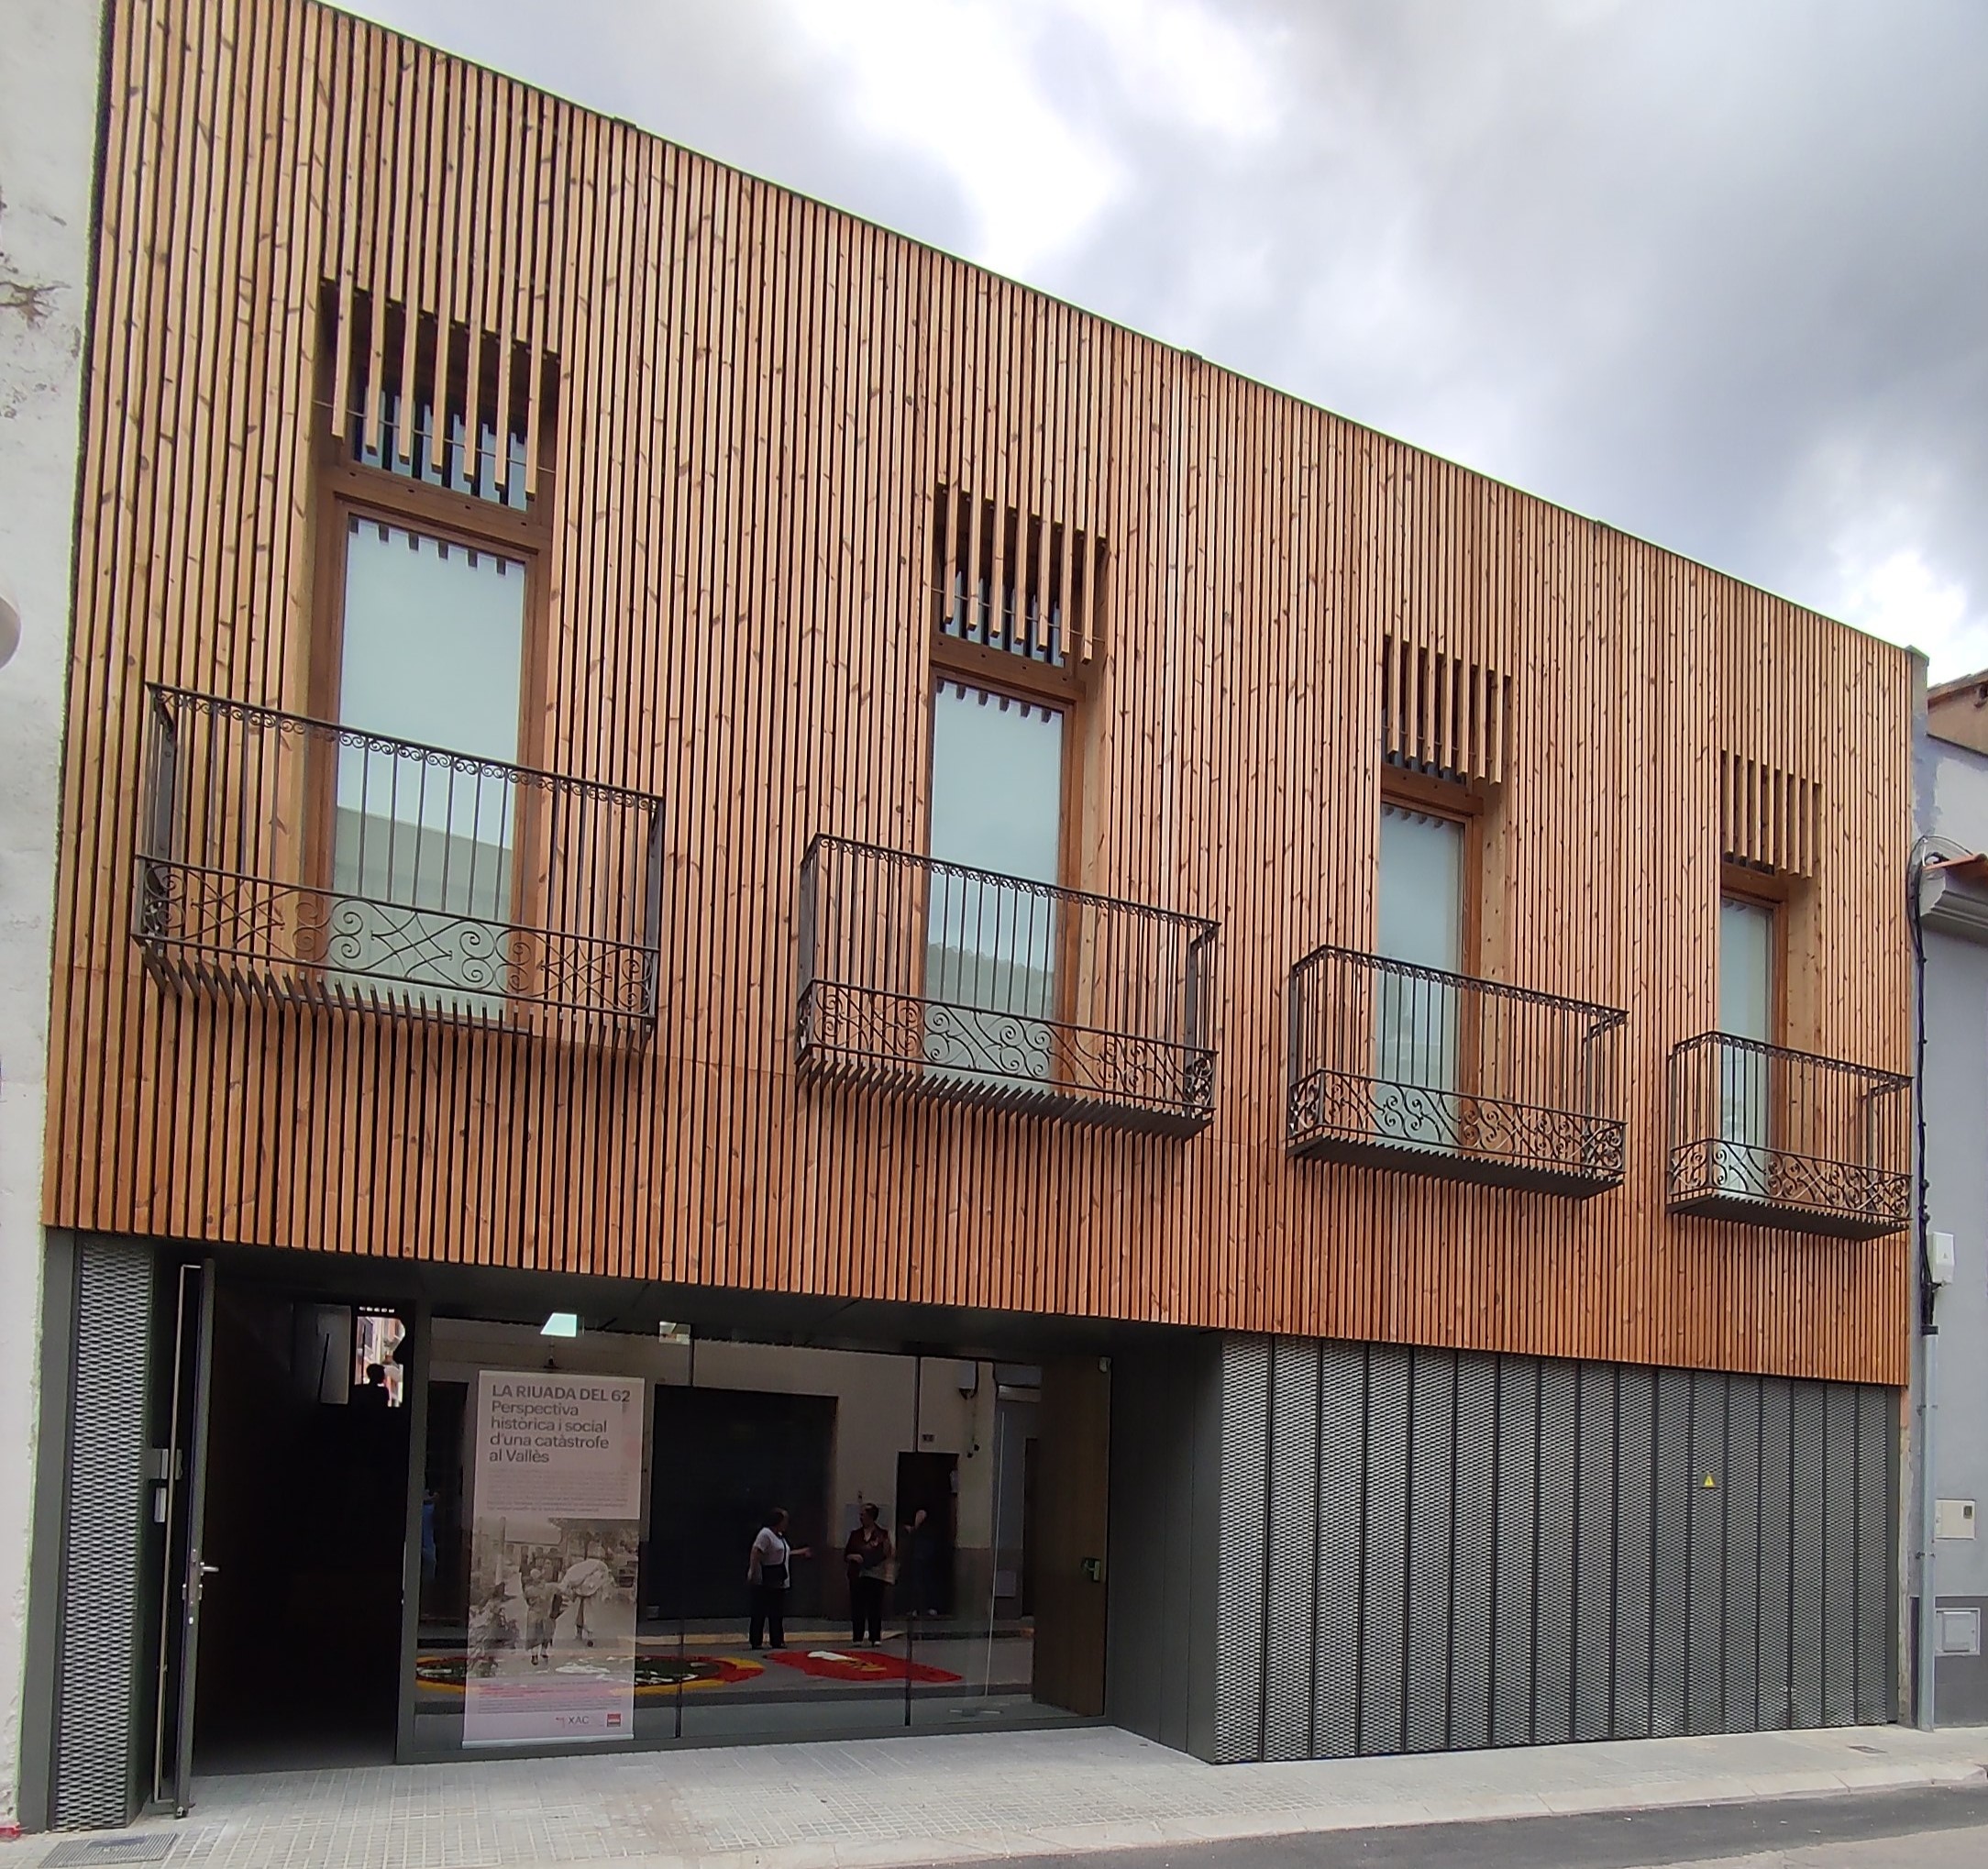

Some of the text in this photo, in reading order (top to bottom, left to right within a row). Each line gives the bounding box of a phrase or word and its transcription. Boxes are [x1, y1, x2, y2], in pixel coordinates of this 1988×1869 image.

[492, 1385, 631, 1402] LA RIUADA DEL 62
[491, 1400, 579, 1416] Perspectiva
[566, 1420, 607, 1433] social
[535, 1433, 610, 1449] catàstrofe
[489, 1449, 549, 1463] al Vallès
[569, 1716, 590, 1725] XAC
